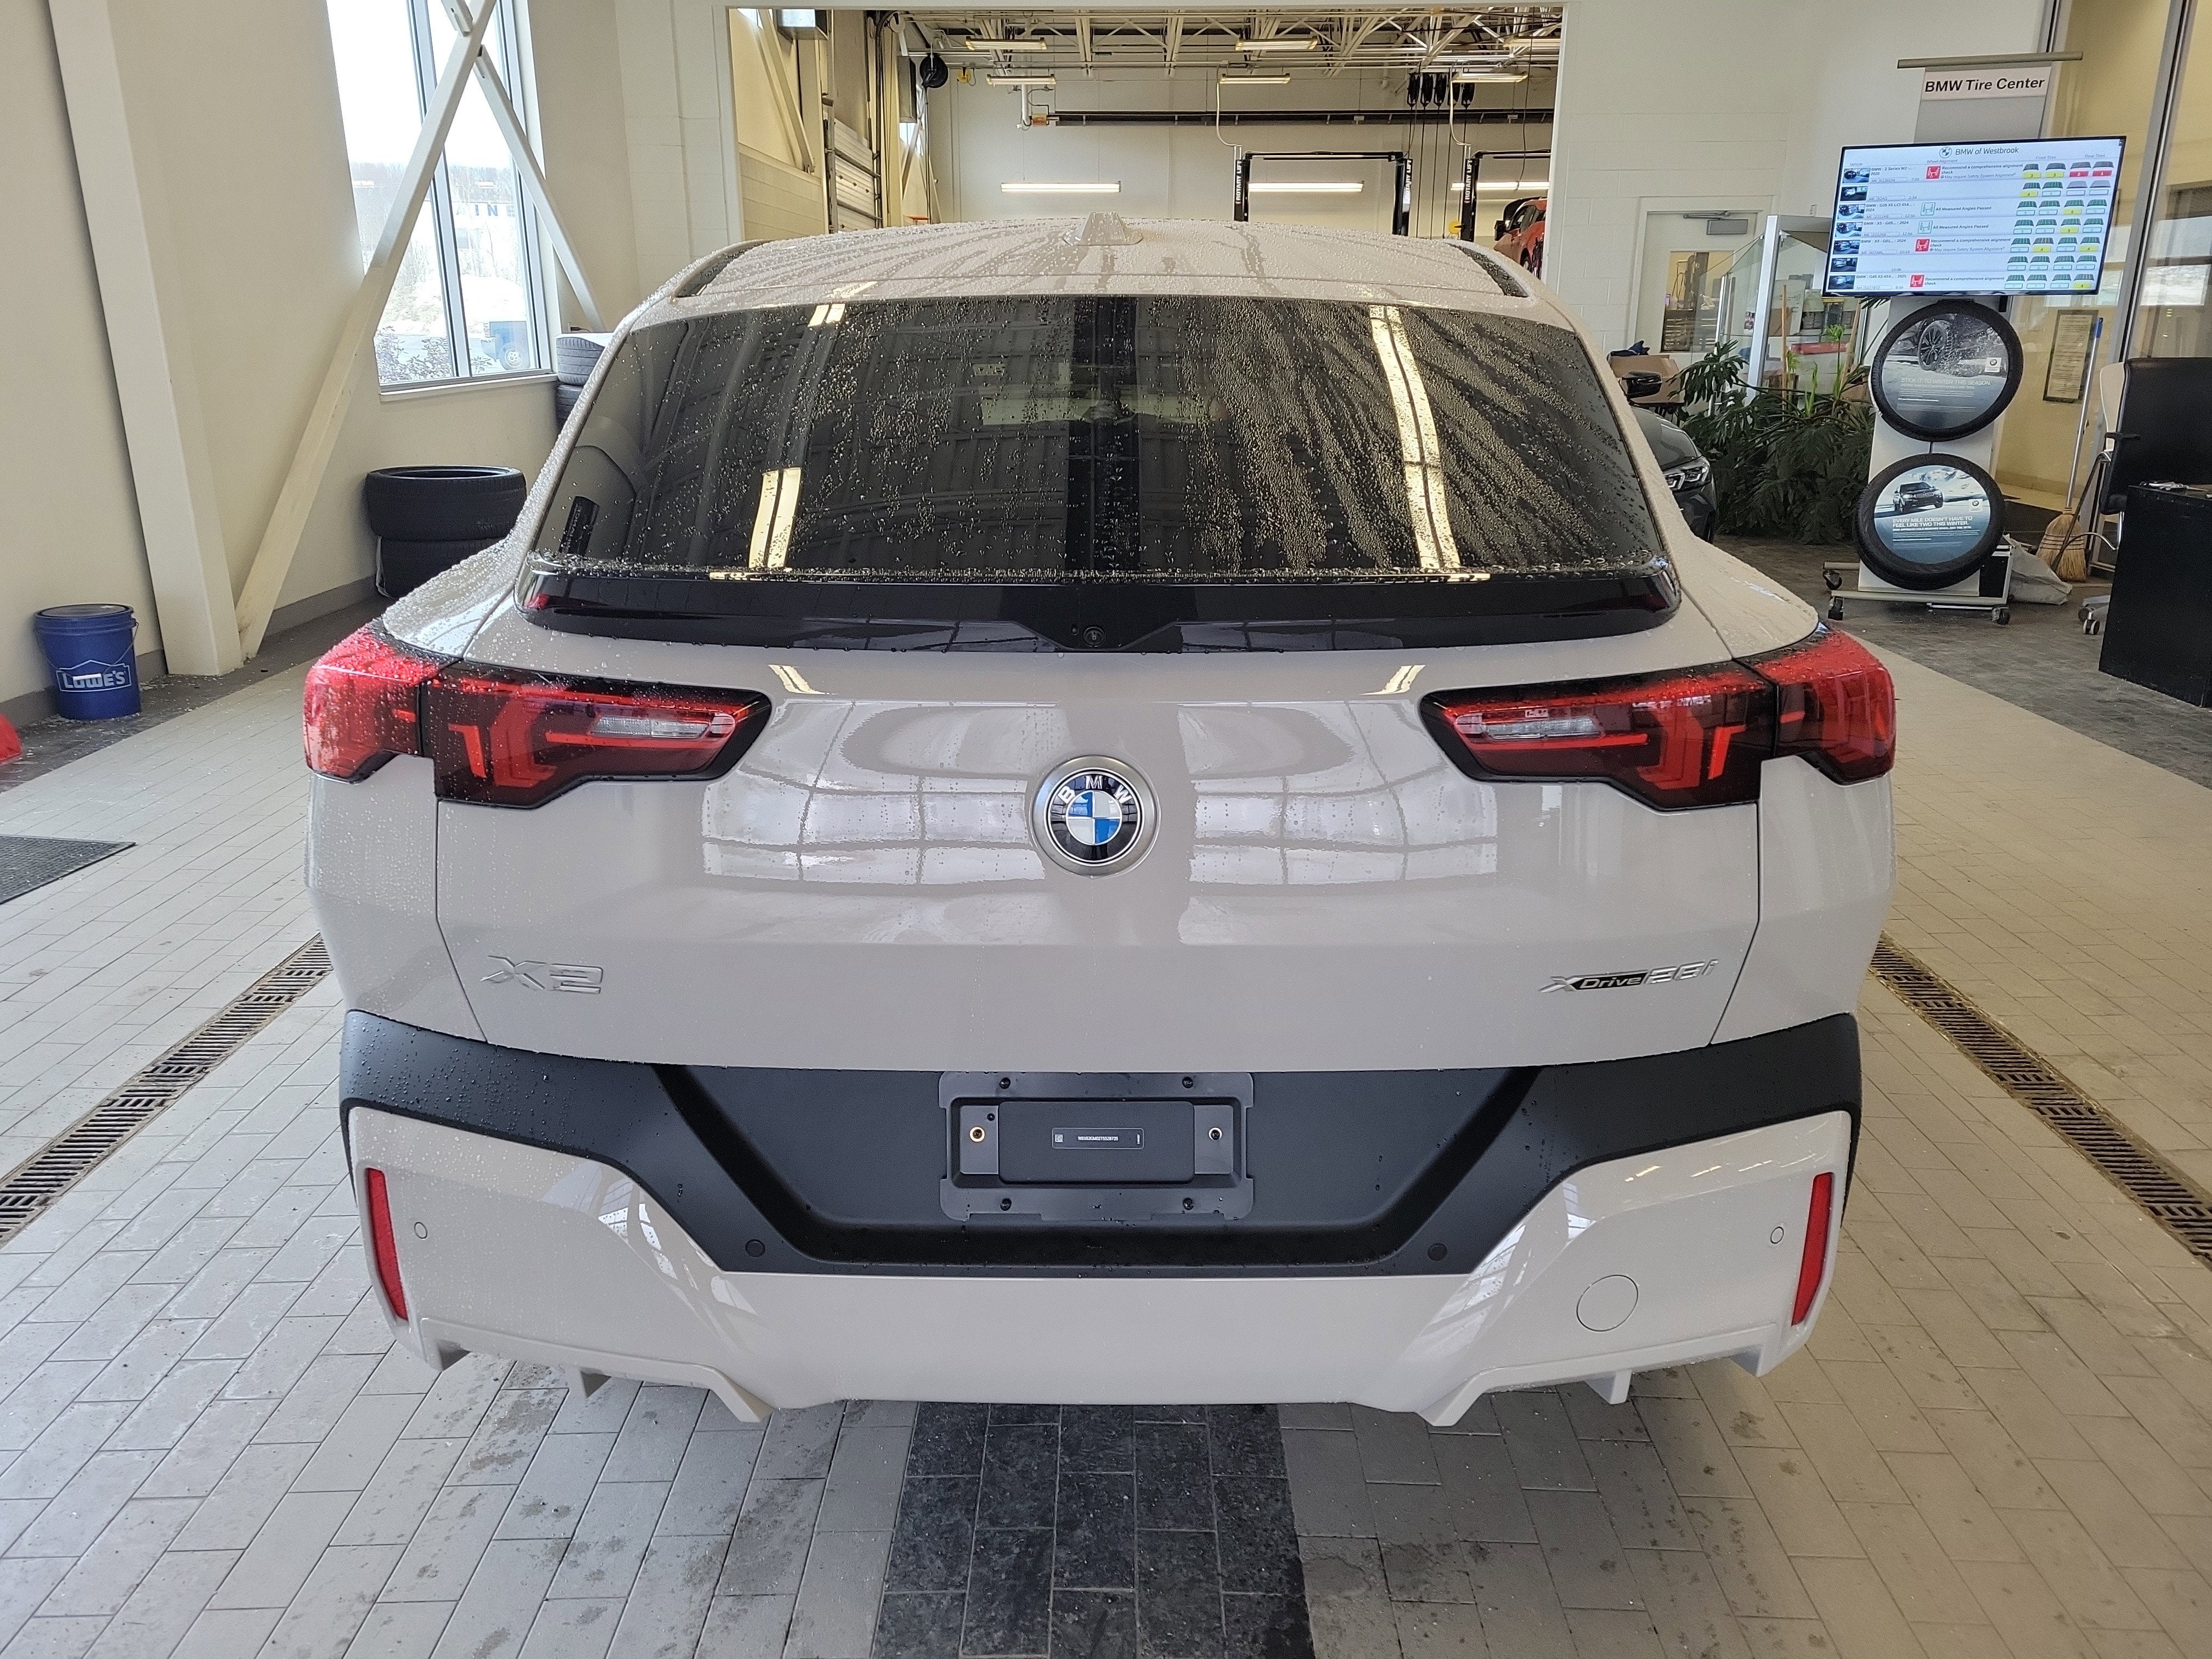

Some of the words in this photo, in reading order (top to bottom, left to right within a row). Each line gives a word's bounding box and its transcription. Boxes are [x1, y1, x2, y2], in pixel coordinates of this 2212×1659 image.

[1925, 80, 1963, 92] BMW
[1966, 79, 1992, 91] Tire
[1996, 78, 2045, 89] Center
[61, 670, 126, 689] LOWE'S
[1057, 775, 1132, 804] BMW
[481, 955, 603, 995] X2
